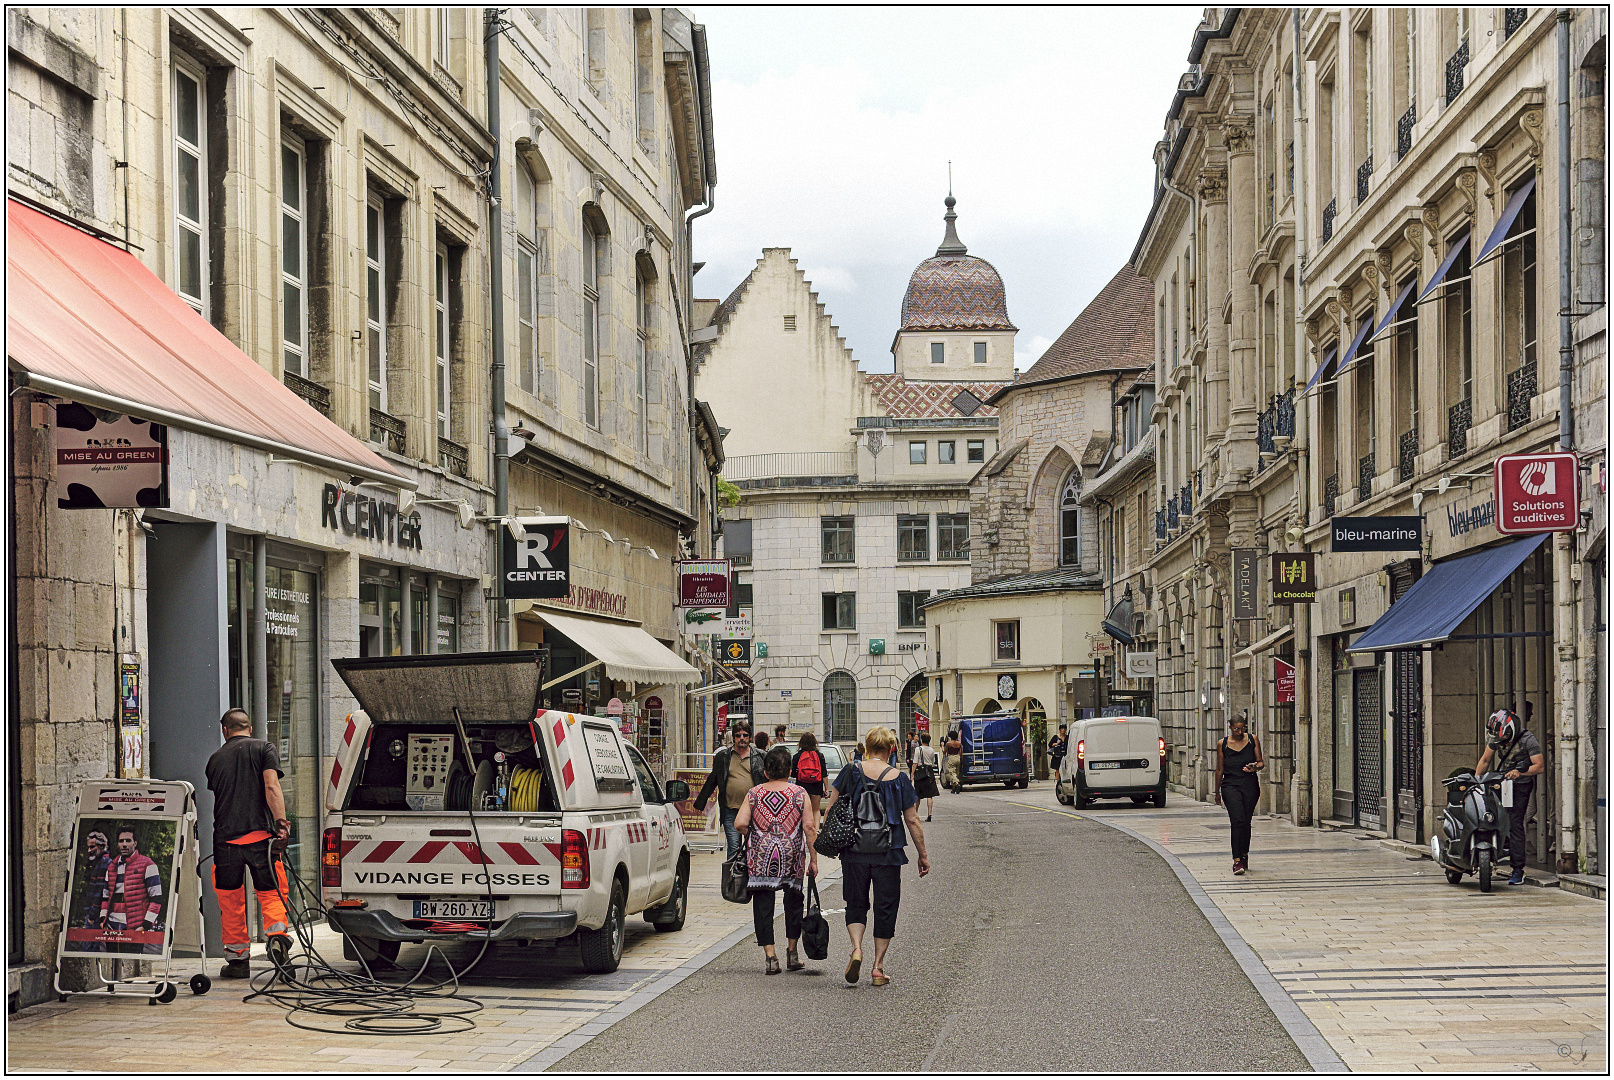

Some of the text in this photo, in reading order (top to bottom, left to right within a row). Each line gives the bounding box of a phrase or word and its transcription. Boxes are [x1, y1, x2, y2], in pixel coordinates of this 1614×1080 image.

[96, 452, 112, 460] AU
[117, 451, 155, 460] GREEN
[1512, 500, 1565, 511] Solutions
[1513, 512, 1566, 523] auditives
[1336, 528, 1417, 541] bleu-marine
[506, 571, 566, 582] CENTER
[1283, 591, 1315, 599] Chocolat
[898, 643, 921, 651] BNP
[1131, 659, 1153, 667] LCL
[354, 872, 551, 886] VIDANGE FOSSES
[421, 903, 487, 917] BW-260-XZ
